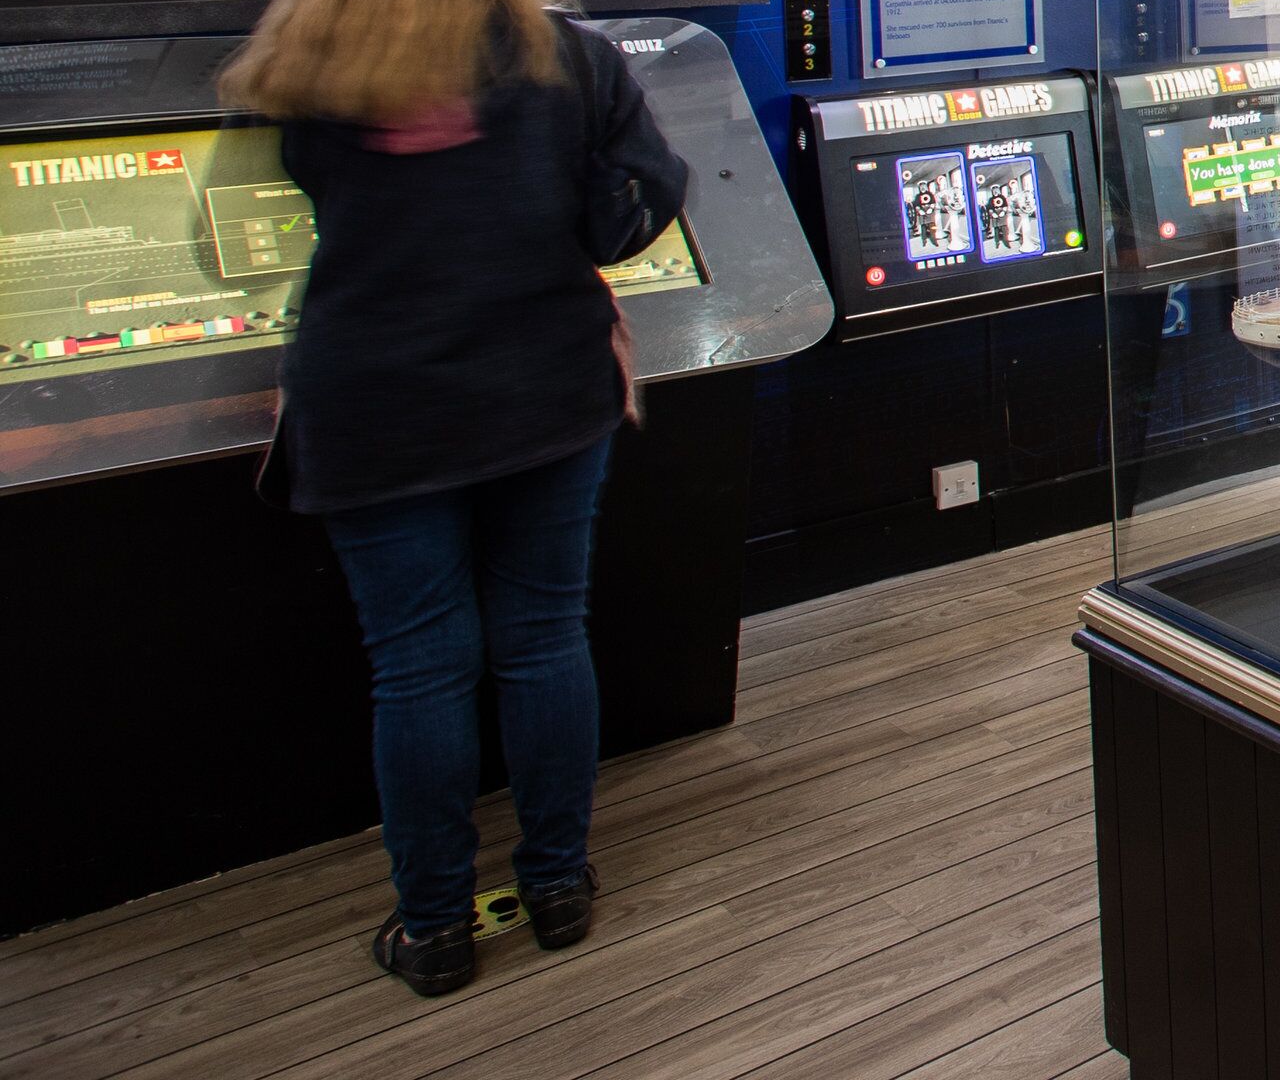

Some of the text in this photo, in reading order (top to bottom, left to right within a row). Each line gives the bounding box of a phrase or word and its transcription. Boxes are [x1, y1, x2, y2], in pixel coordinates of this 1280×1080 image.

[804, 24, 813, 36] 2
[622, 38, 664, 54] QUIZ
[805, 58, 815, 70] 3
[1145, 67, 1219, 103] TITANIC
[858, 83, 1052, 131] TITANIC GAMES
[967, 139, 1033, 160] Detective
[10, 153, 137, 187] TITANIC
[1191, 164, 1215, 180] You
[1217, 160, 1245, 177] have
[1248, 157, 1275, 171] done
